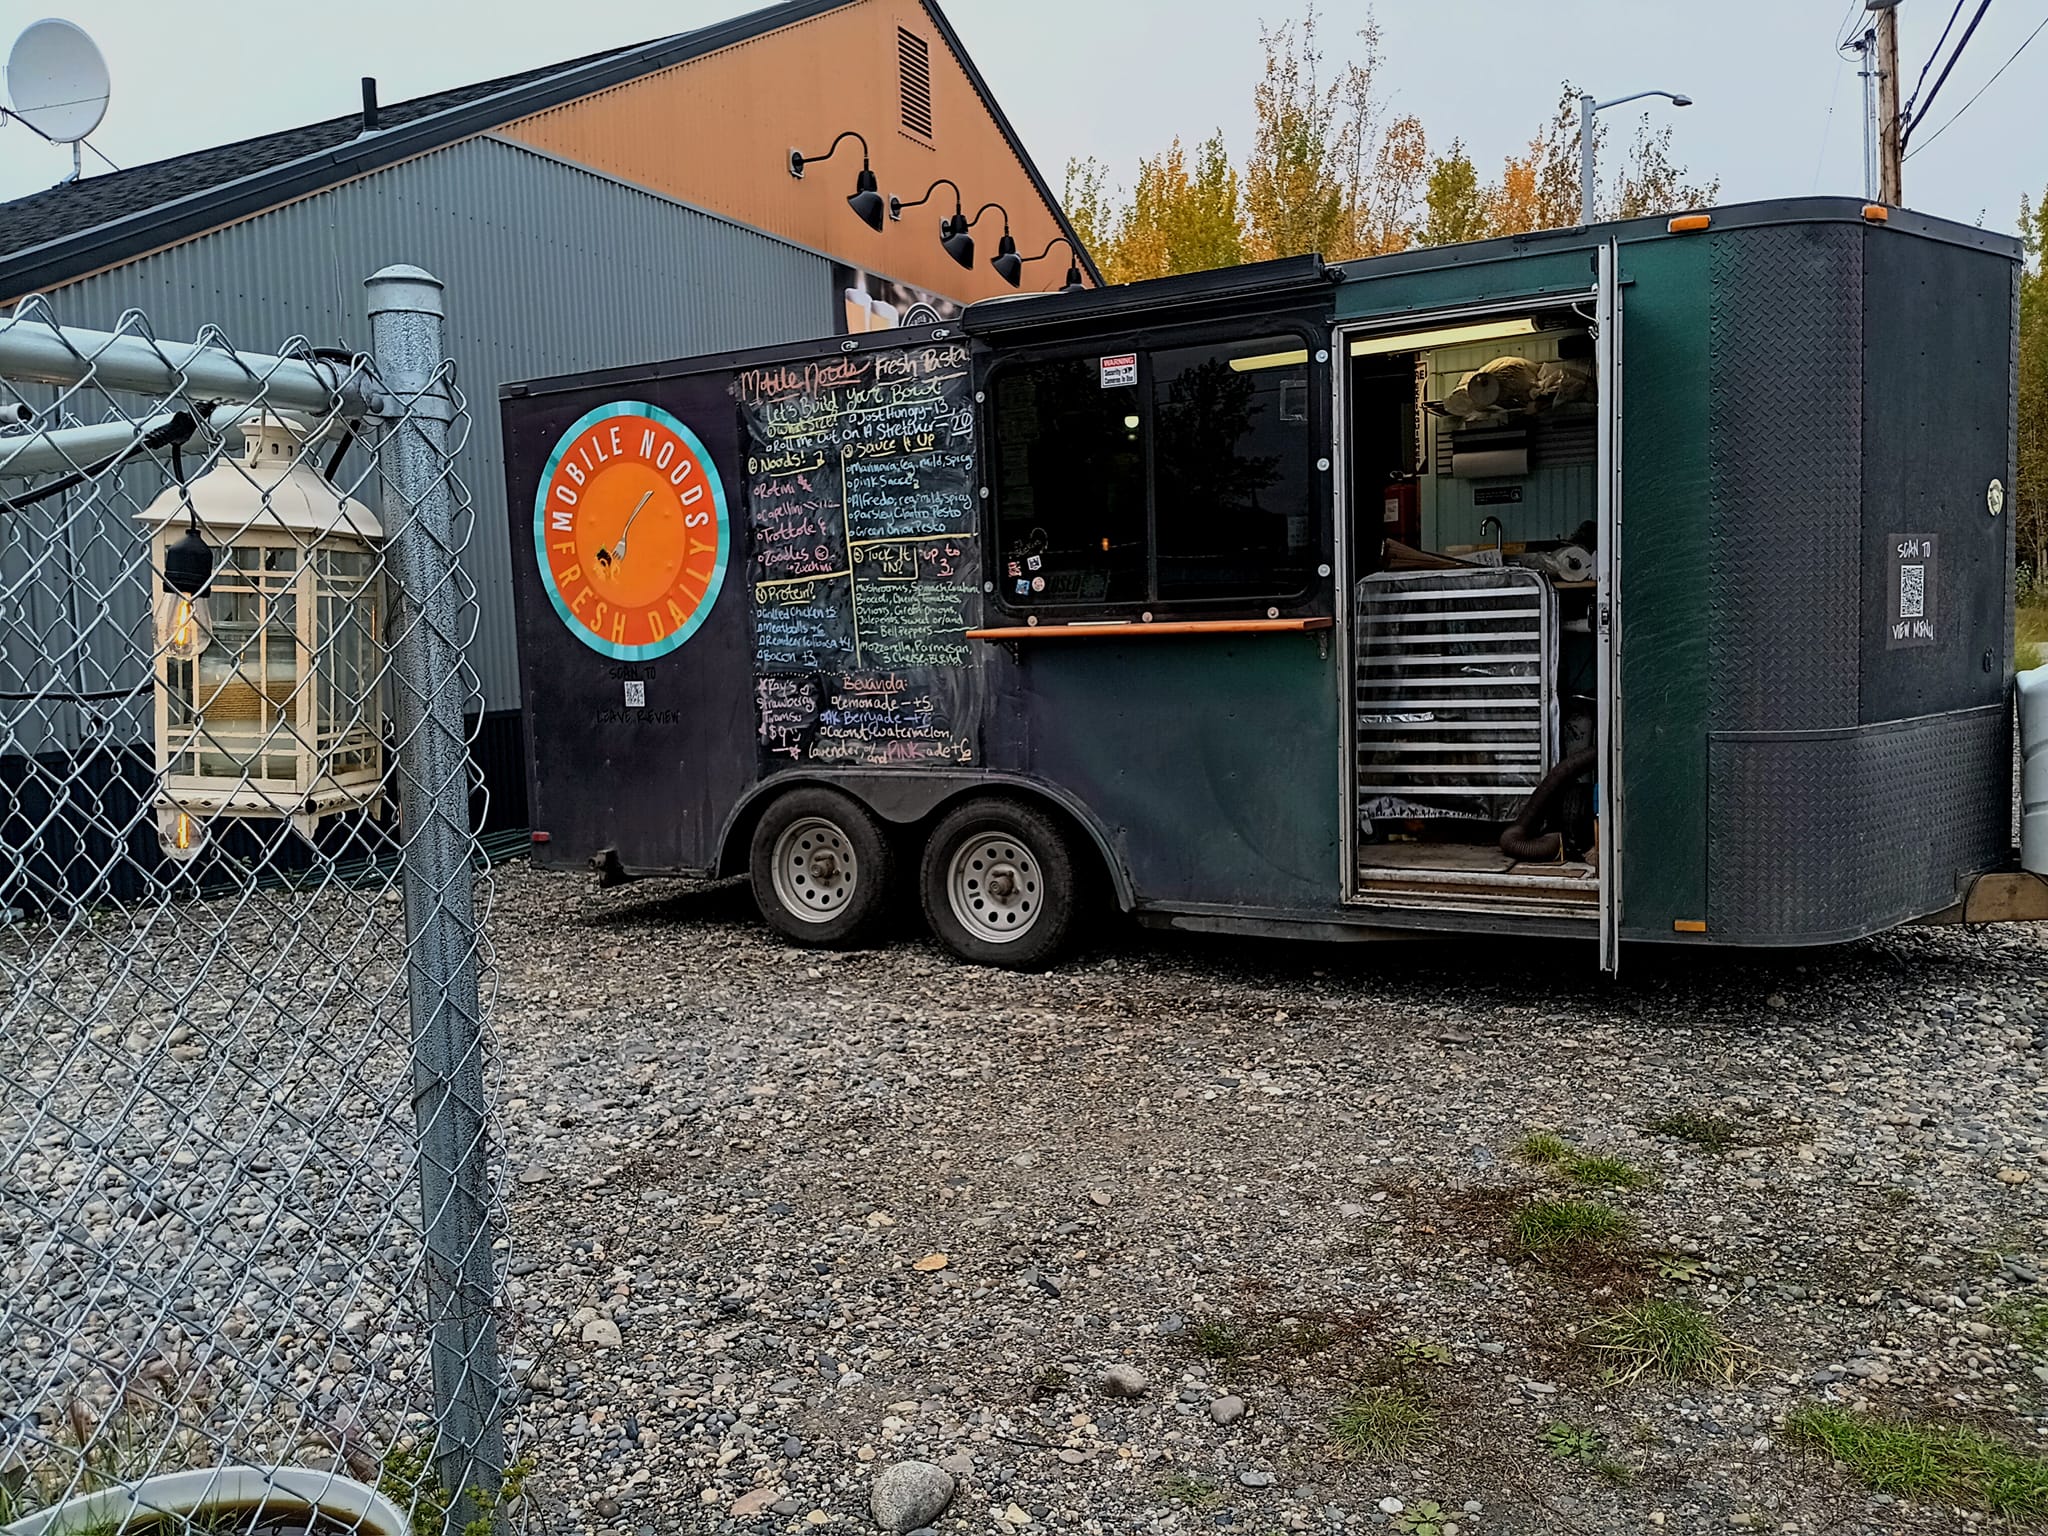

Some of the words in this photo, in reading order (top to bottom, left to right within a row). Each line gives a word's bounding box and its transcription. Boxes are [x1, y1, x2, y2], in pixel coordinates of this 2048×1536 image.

[741, 366, 801, 404] Mobile
[803, 356, 870, 397] Noods
[874, 355, 918, 380] Fresh
[766, 402, 798, 425] Let's
[799, 391, 840, 418] Build
[846, 385, 884, 412] Your
[772, 438, 797, 454] Roll
[863, 423, 873, 439] A
[856, 440, 897, 458] Sauce
[551, 426, 623, 533] MOBILE
[639, 428, 710, 529] NOODS
[863, 545, 895, 562] Tuck
[1897, 538, 1919, 559] SCAN
[552, 541, 627, 645] FRESH
[647, 537, 716, 642] DAILY
[767, 580, 817, 601] Protein?
[886, 740, 925, 762] PINK
